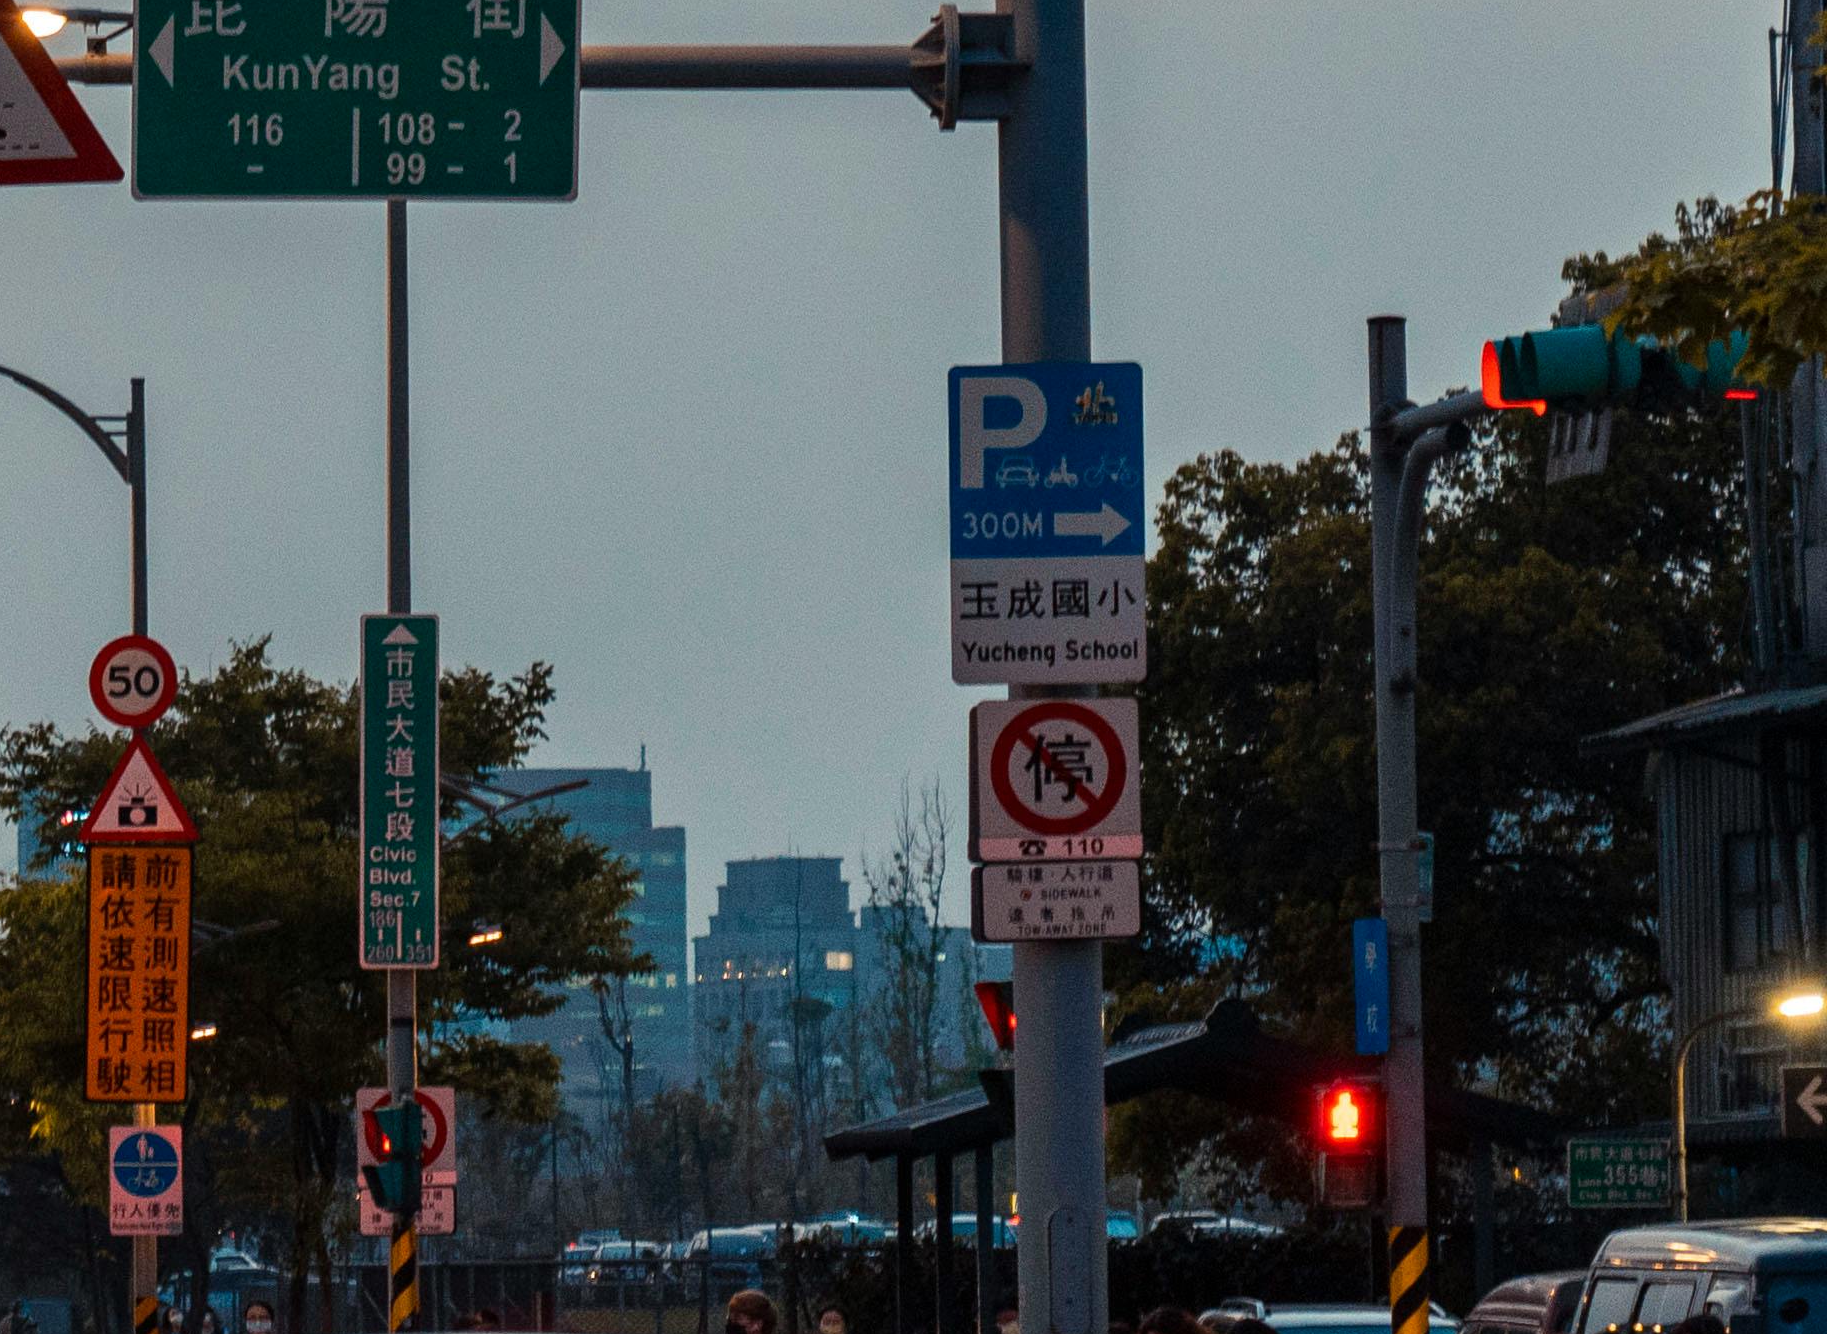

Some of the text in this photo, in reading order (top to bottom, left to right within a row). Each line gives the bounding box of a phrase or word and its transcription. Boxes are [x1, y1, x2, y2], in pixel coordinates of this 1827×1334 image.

[223, 54, 491, 100] KunYang St.
[228, 113, 284, 146] 116
[962, 512, 1044, 539] 300M
[960, 579, 1137, 620] 玉成國小
[961, 638, 1138, 666] Yucheng School
[108, 665, 161, 699] 50
[384, 650, 415, 842] 市民大道七段
[1025, 733, 1094, 803] 停
[370, 846, 417, 863] Civic
[1061, 838, 1104, 856] 110
[369, 869, 417, 885] Blvd.
[1041, 887, 1102, 900] SIDEWALK
[97, 854, 137, 1095] 請依速限行駛
[141, 853, 181, 1094] 前有測速照相
[113, 1202, 180, 1218] 行人優先
